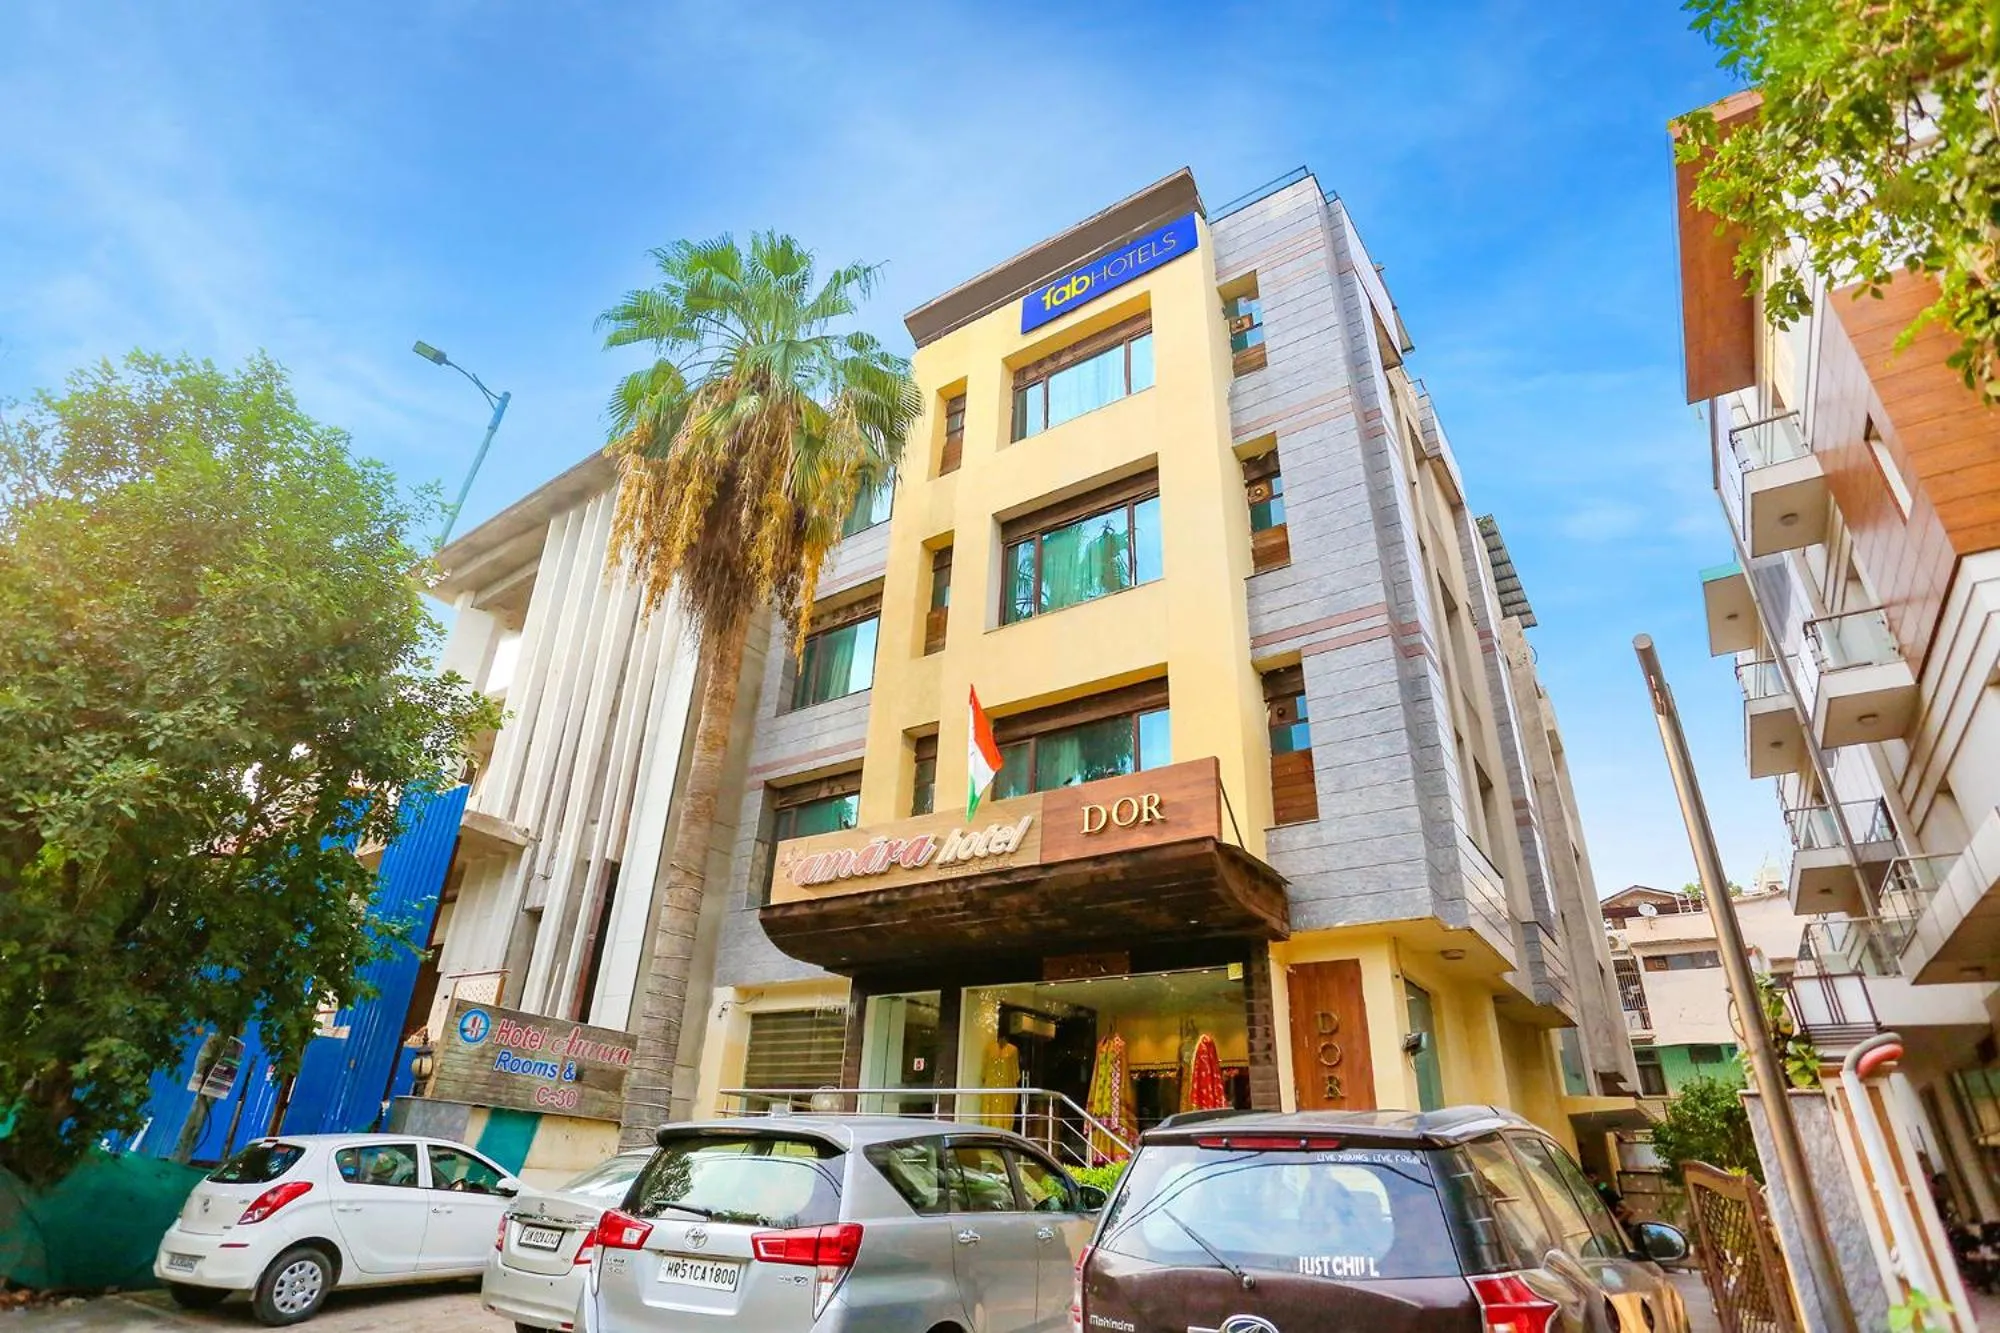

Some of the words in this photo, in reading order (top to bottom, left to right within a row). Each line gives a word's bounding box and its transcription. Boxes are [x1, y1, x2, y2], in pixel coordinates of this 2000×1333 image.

[1080, 792, 1165, 834] DOR
[936, 815, 1032, 863] hotel
[495, 1018, 549, 1052] Hotel
[494, 1050, 560, 1080] Rooms
[562, 1061, 577, 1082] &
[1316, 1011, 1346, 1100] DOR
[536, 1087, 578, 1109] C-30
